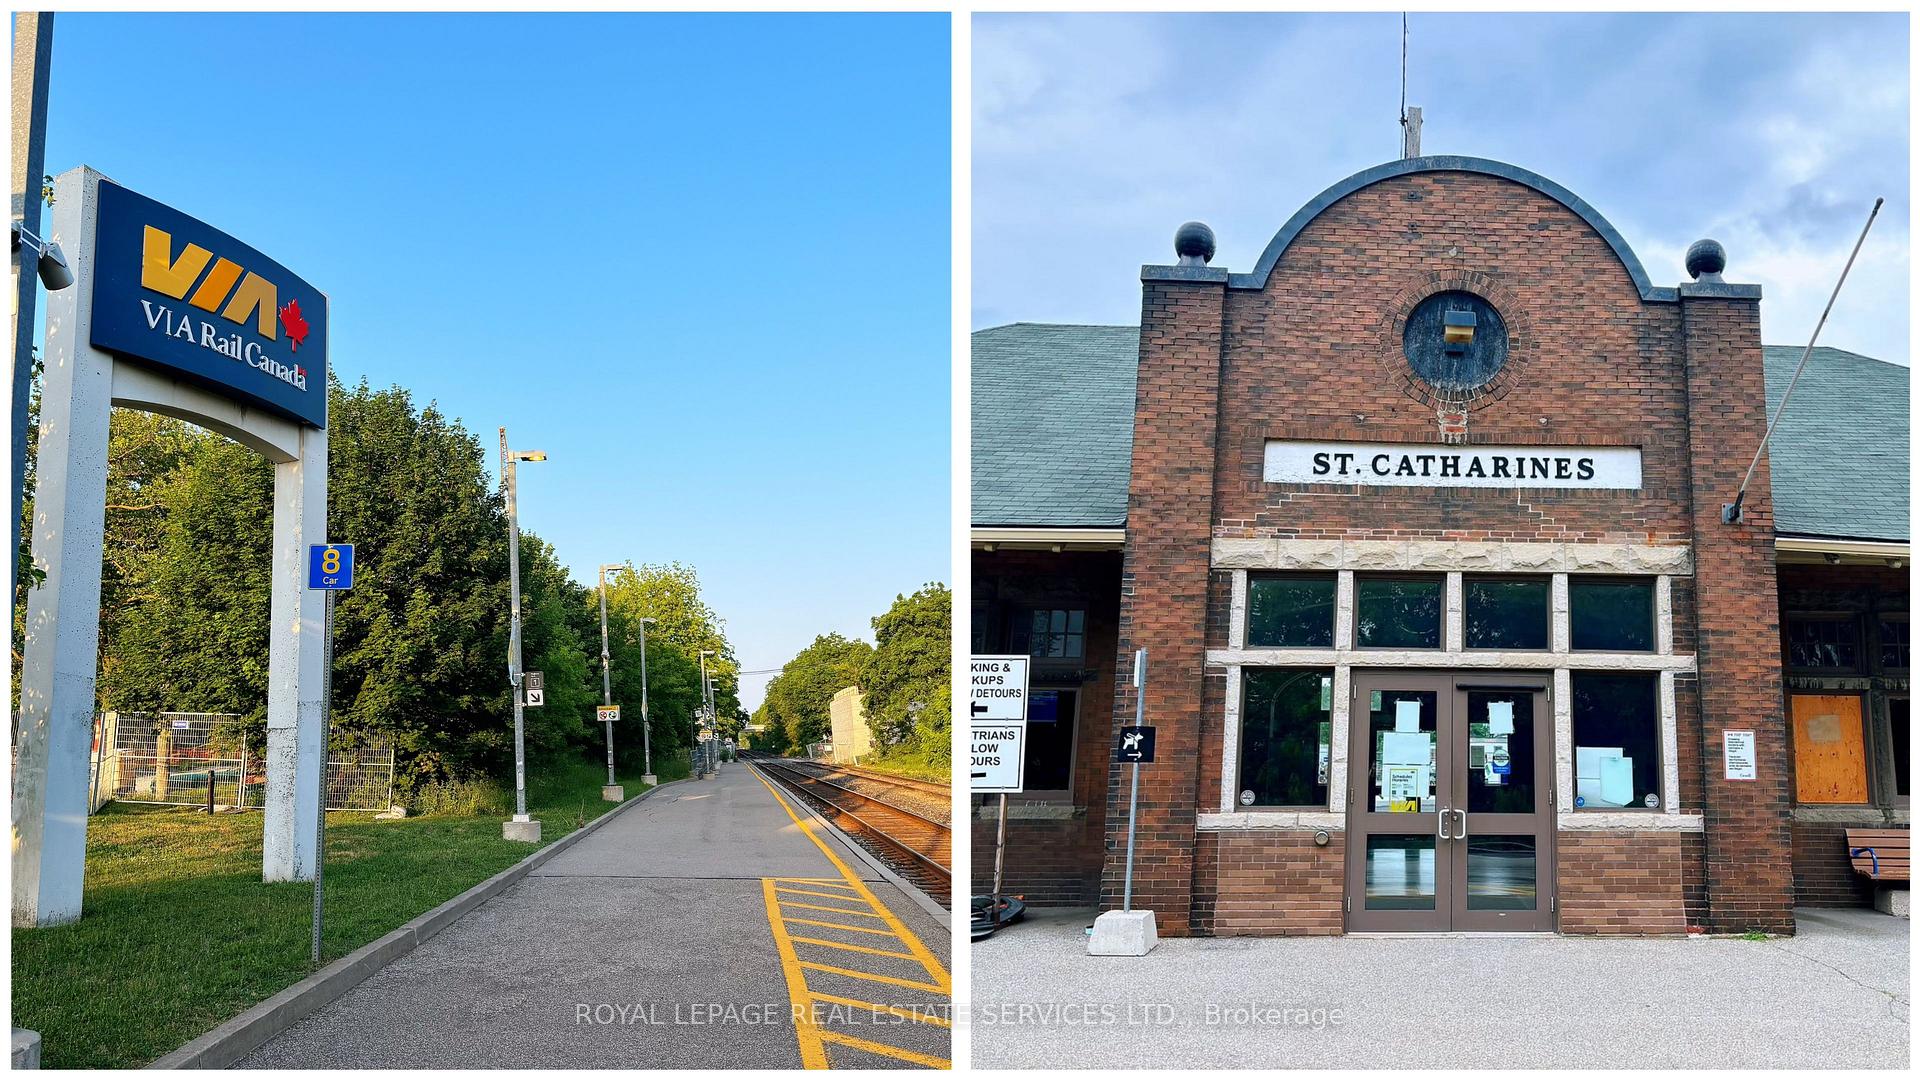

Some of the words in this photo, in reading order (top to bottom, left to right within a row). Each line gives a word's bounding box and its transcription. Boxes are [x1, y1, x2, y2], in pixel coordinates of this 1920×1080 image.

[141, 225, 277, 341] VIA
[141, 299, 196, 343] VIA
[200, 321, 242, 361] Rail
[245, 342, 307, 392] Canada
[1313, 453, 1361, 475] ST.
[1371, 454, 1595, 480] CATHARINES
[322, 548, 340, 574] 8
[322, 576, 338, 585] Car
[1002, 663, 1010, 672] &
[972, 675, 1004, 685] KUPS
[976, 688, 1022, 698] DETOURS
[972, 730, 1015, 740] TRIANS
[971, 743, 999, 753] LOW
